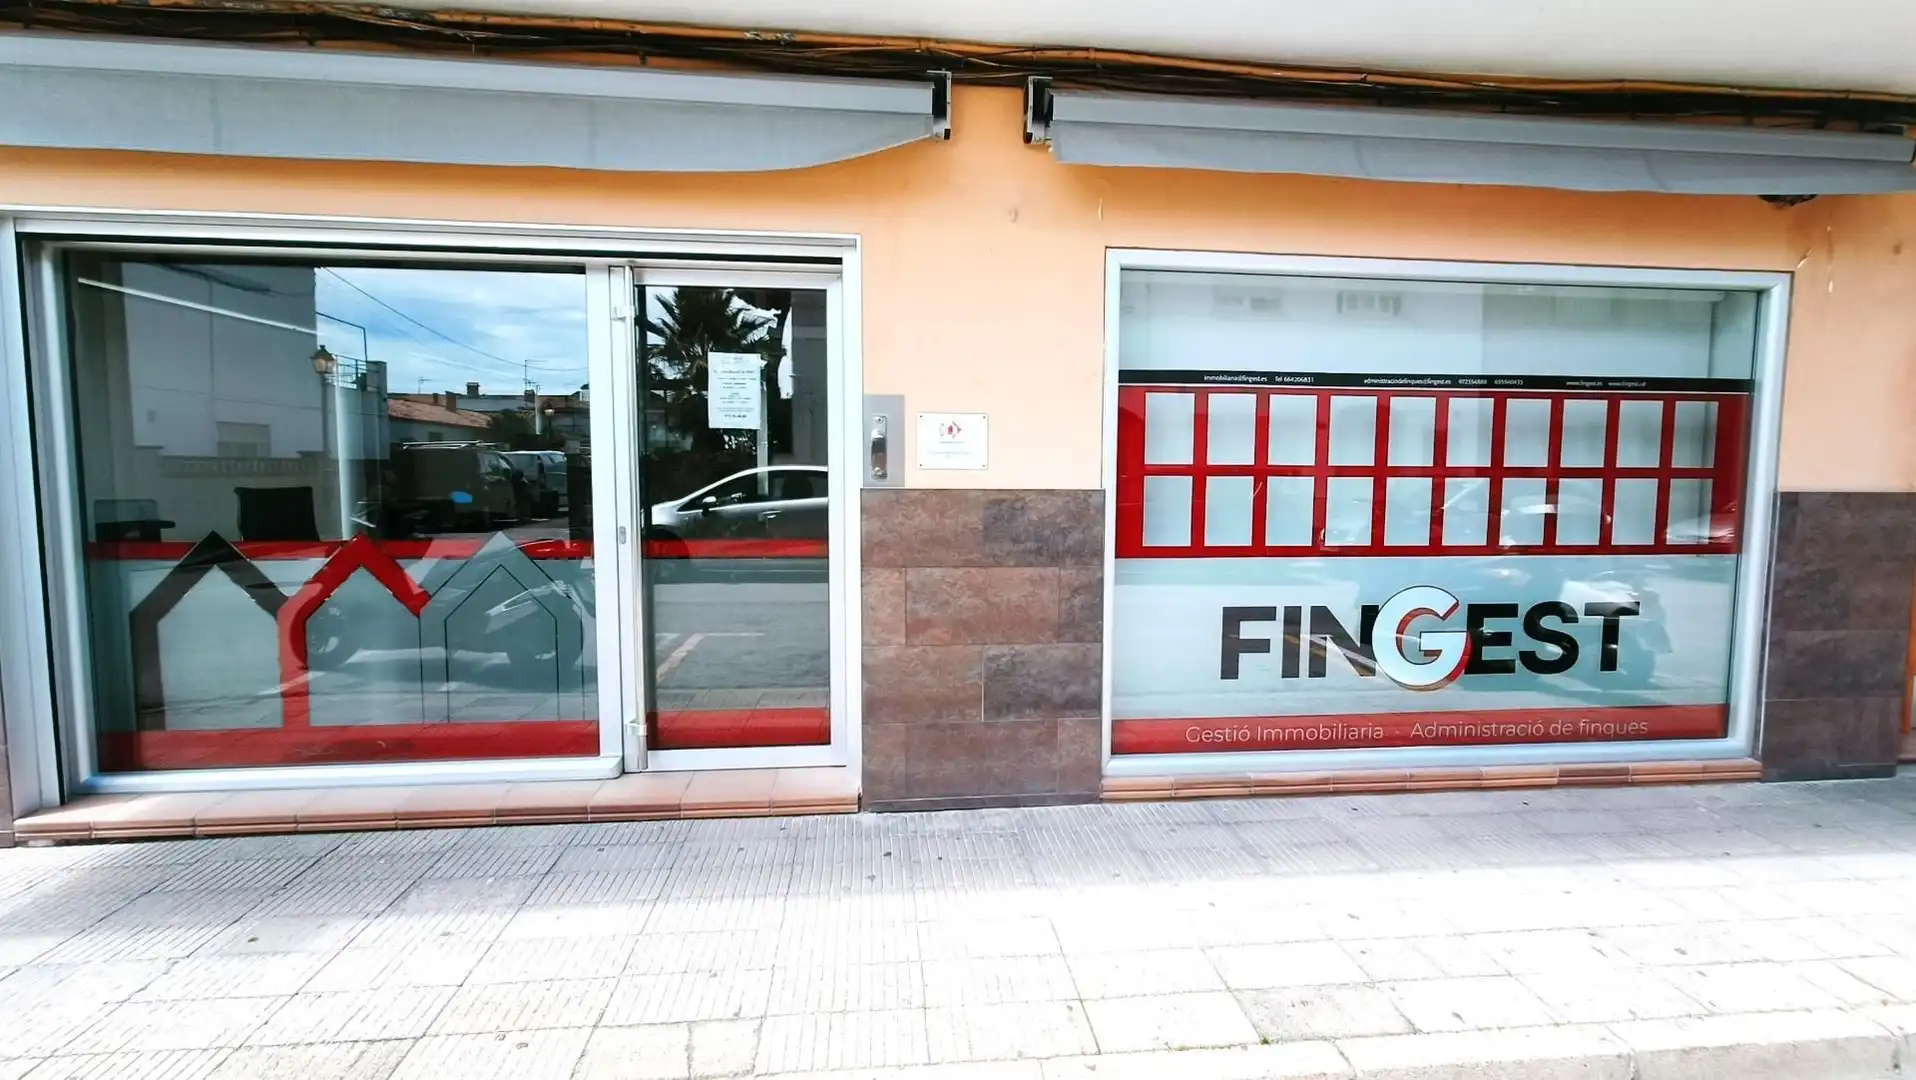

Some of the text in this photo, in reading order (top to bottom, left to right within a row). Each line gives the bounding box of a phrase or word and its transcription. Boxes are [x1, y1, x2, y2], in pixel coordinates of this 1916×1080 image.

[1220, 585, 1641, 691] FINGEST
[1185, 722, 1384, 743] Gestió Immobiliaria
[1410, 718, 1649, 739] Administració de finques
